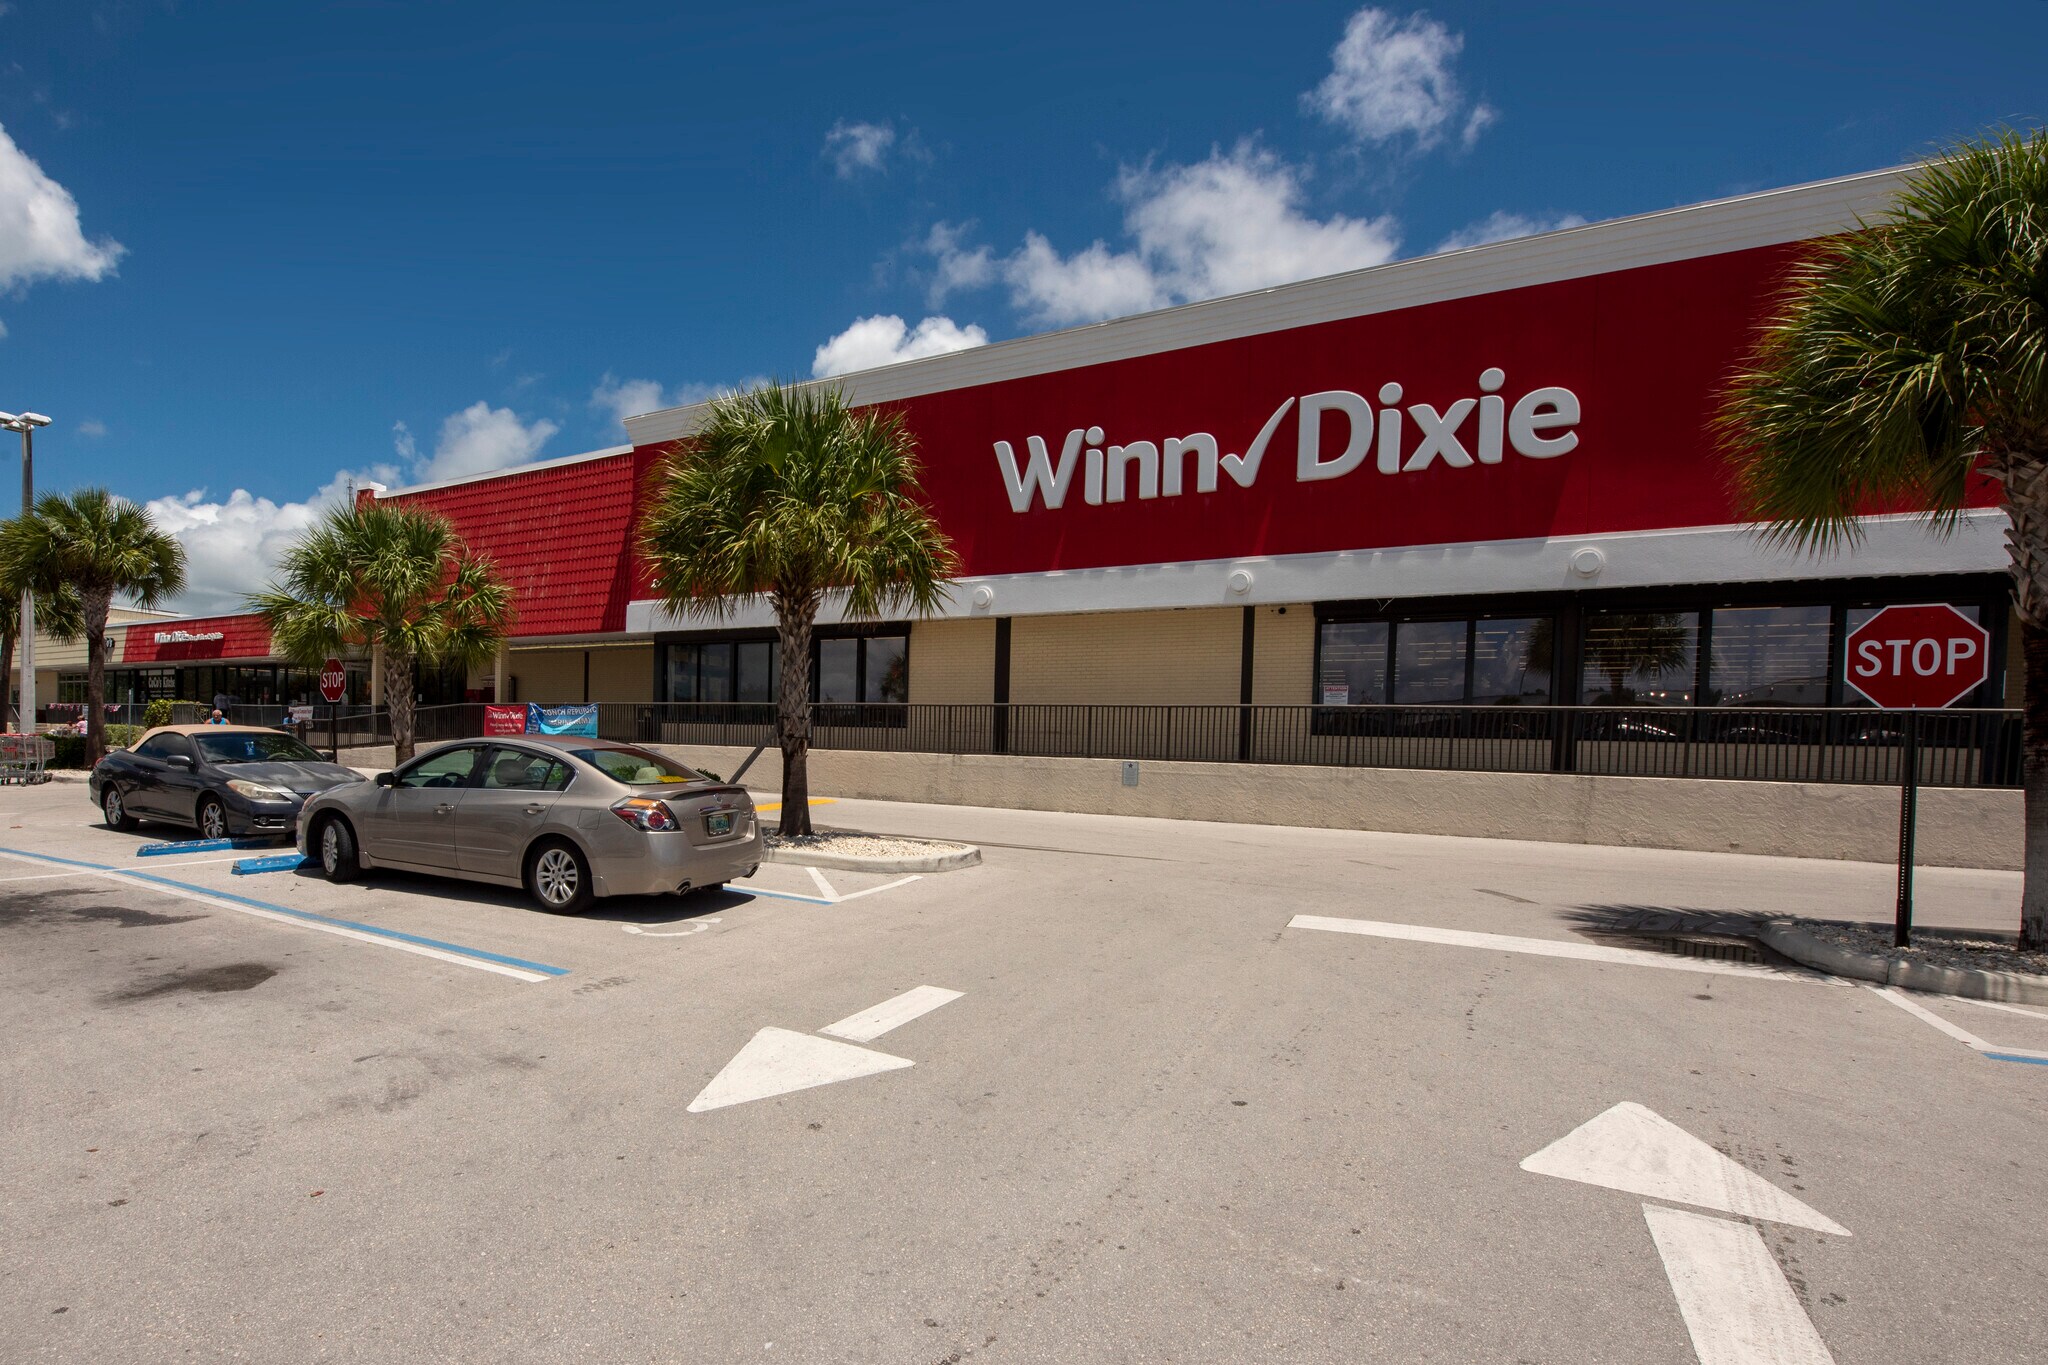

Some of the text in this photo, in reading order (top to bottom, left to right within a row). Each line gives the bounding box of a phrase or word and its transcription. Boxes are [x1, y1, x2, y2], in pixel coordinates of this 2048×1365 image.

[993, 367, 1581, 513] Winn Dixie
[1855, 638, 1977, 677] STOP
[322, 672, 344, 688] STOP
[542, 708, 567, 716] CONCH
